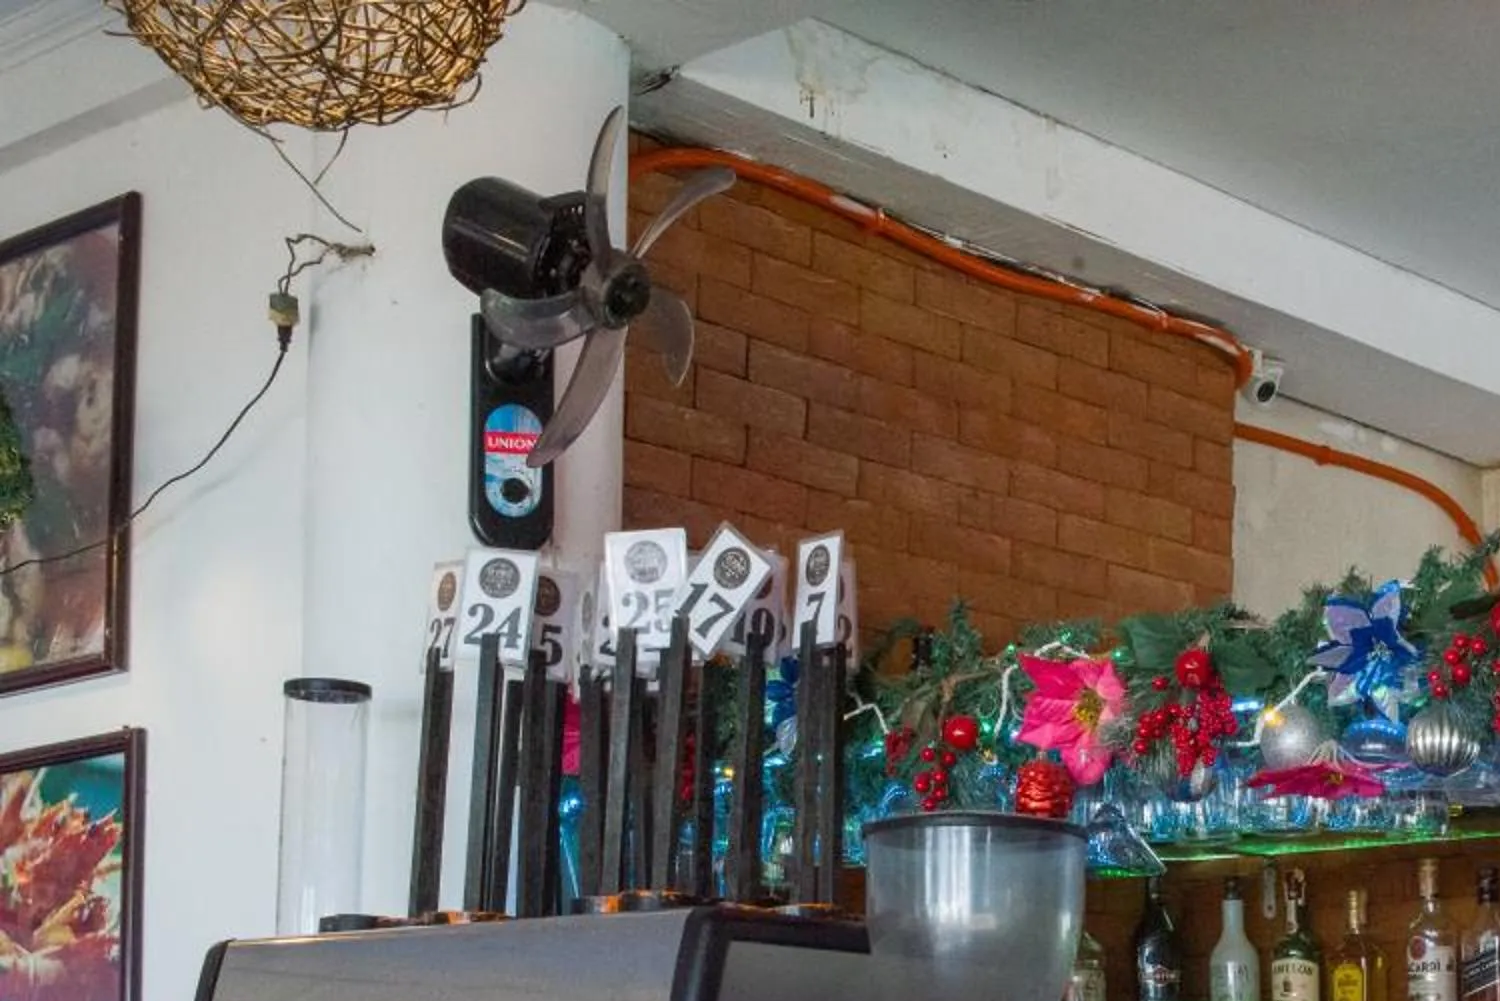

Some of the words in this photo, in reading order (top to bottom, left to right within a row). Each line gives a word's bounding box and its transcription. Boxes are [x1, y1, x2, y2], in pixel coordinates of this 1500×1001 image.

[487, 435, 537, 449] UNION
[463, 602, 523, 649] 24
[621, 588, 676, 634] 25
[673, 583, 735, 638] 17
[806, 591, 826, 643] 7
[429, 617, 456, 659] 27
[540, 622, 563, 667] 5
